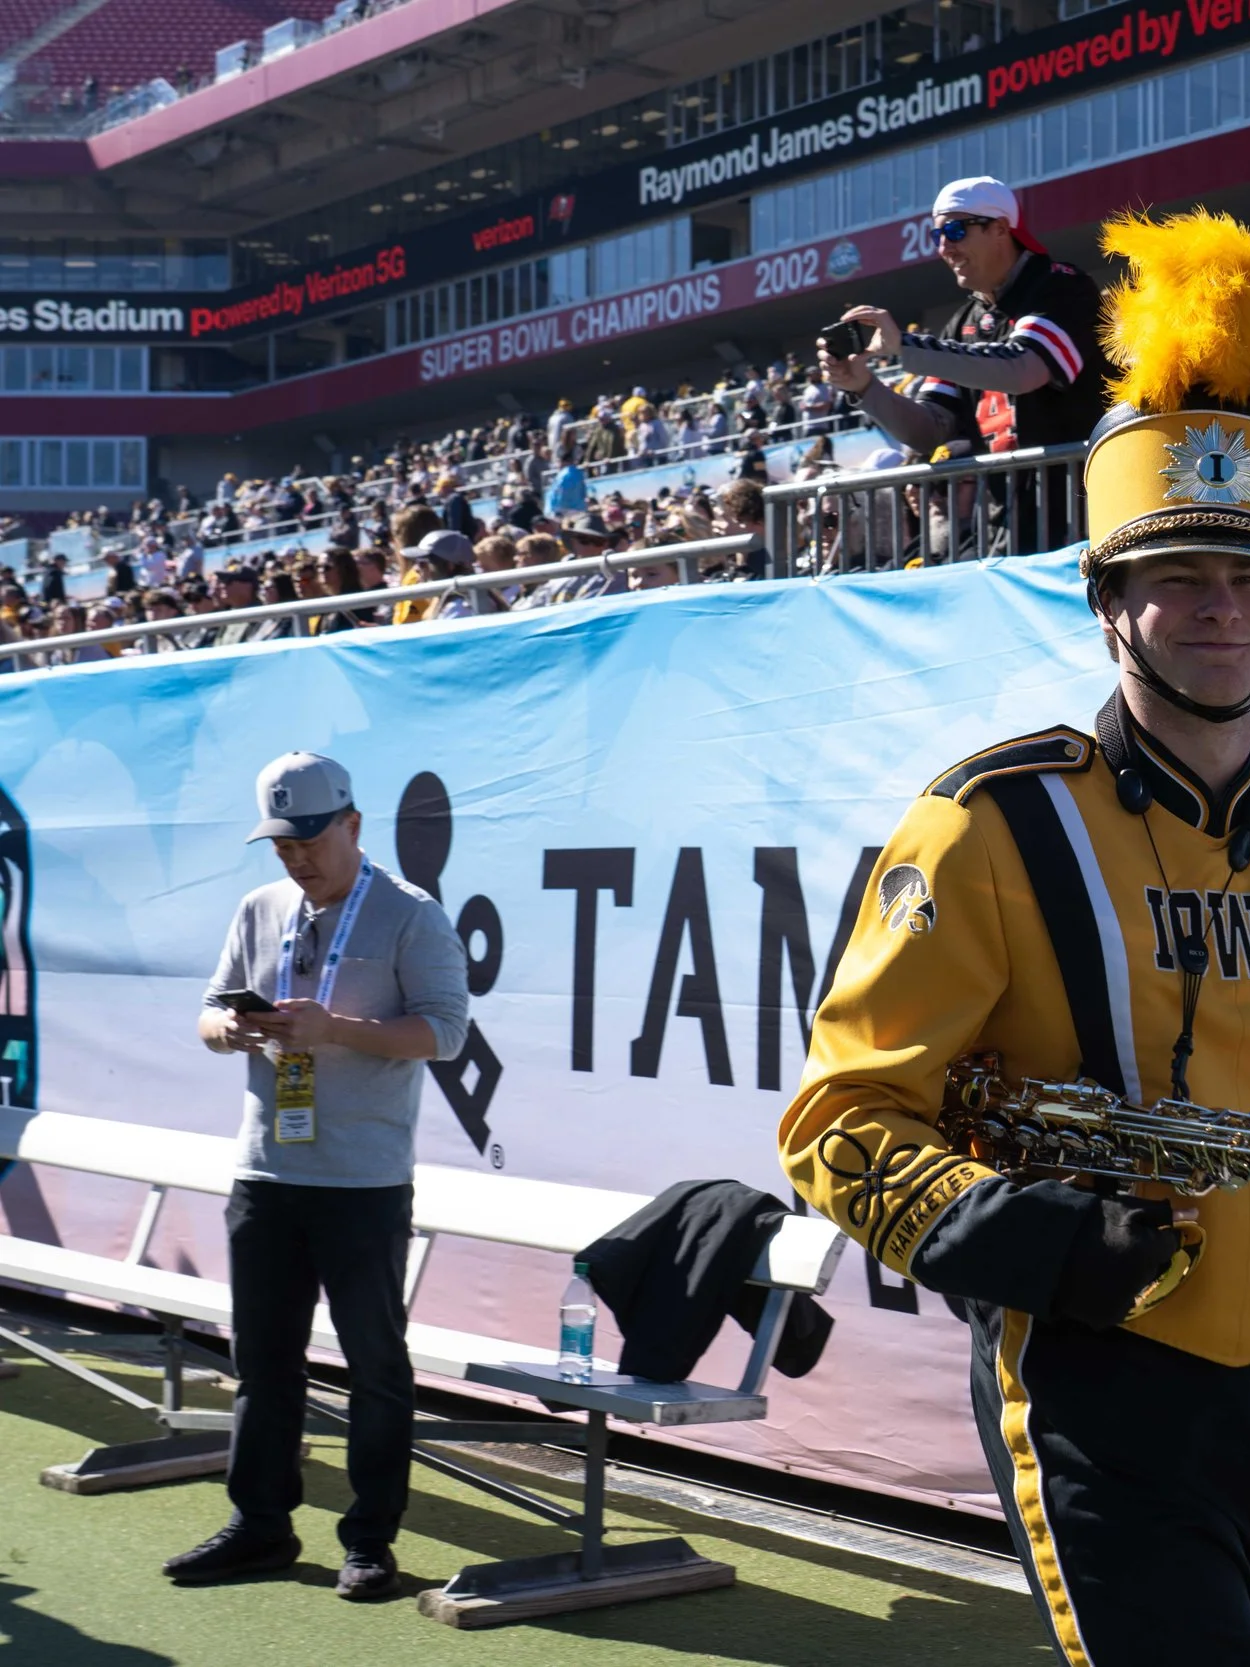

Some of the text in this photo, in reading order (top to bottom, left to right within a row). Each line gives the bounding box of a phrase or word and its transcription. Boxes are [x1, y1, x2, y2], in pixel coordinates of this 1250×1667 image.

[640, 133, 760, 205] Raymond
[762, 114, 854, 168] James
[856, 72, 983, 139] Stadium
[987, 13, 1133, 109] powered
[1137, 9, 1183, 56] by
[472, 214, 534, 252] verizon
[33, 298, 184, 332] Stadium
[190, 282, 281, 338] powered
[281, 279, 304, 315] by
[305, 263, 376, 305] Verizon
[376, 245, 407, 284] 5G
[420, 333, 493, 382] SUPER
[499, 312, 566, 363] BOWL
[570, 273, 722, 344] CHAMPIONS
[755, 247, 820, 299] 2002
[542, 845, 884, 1092] TAM
[889, 1166, 976, 1260] HAWKEYES
